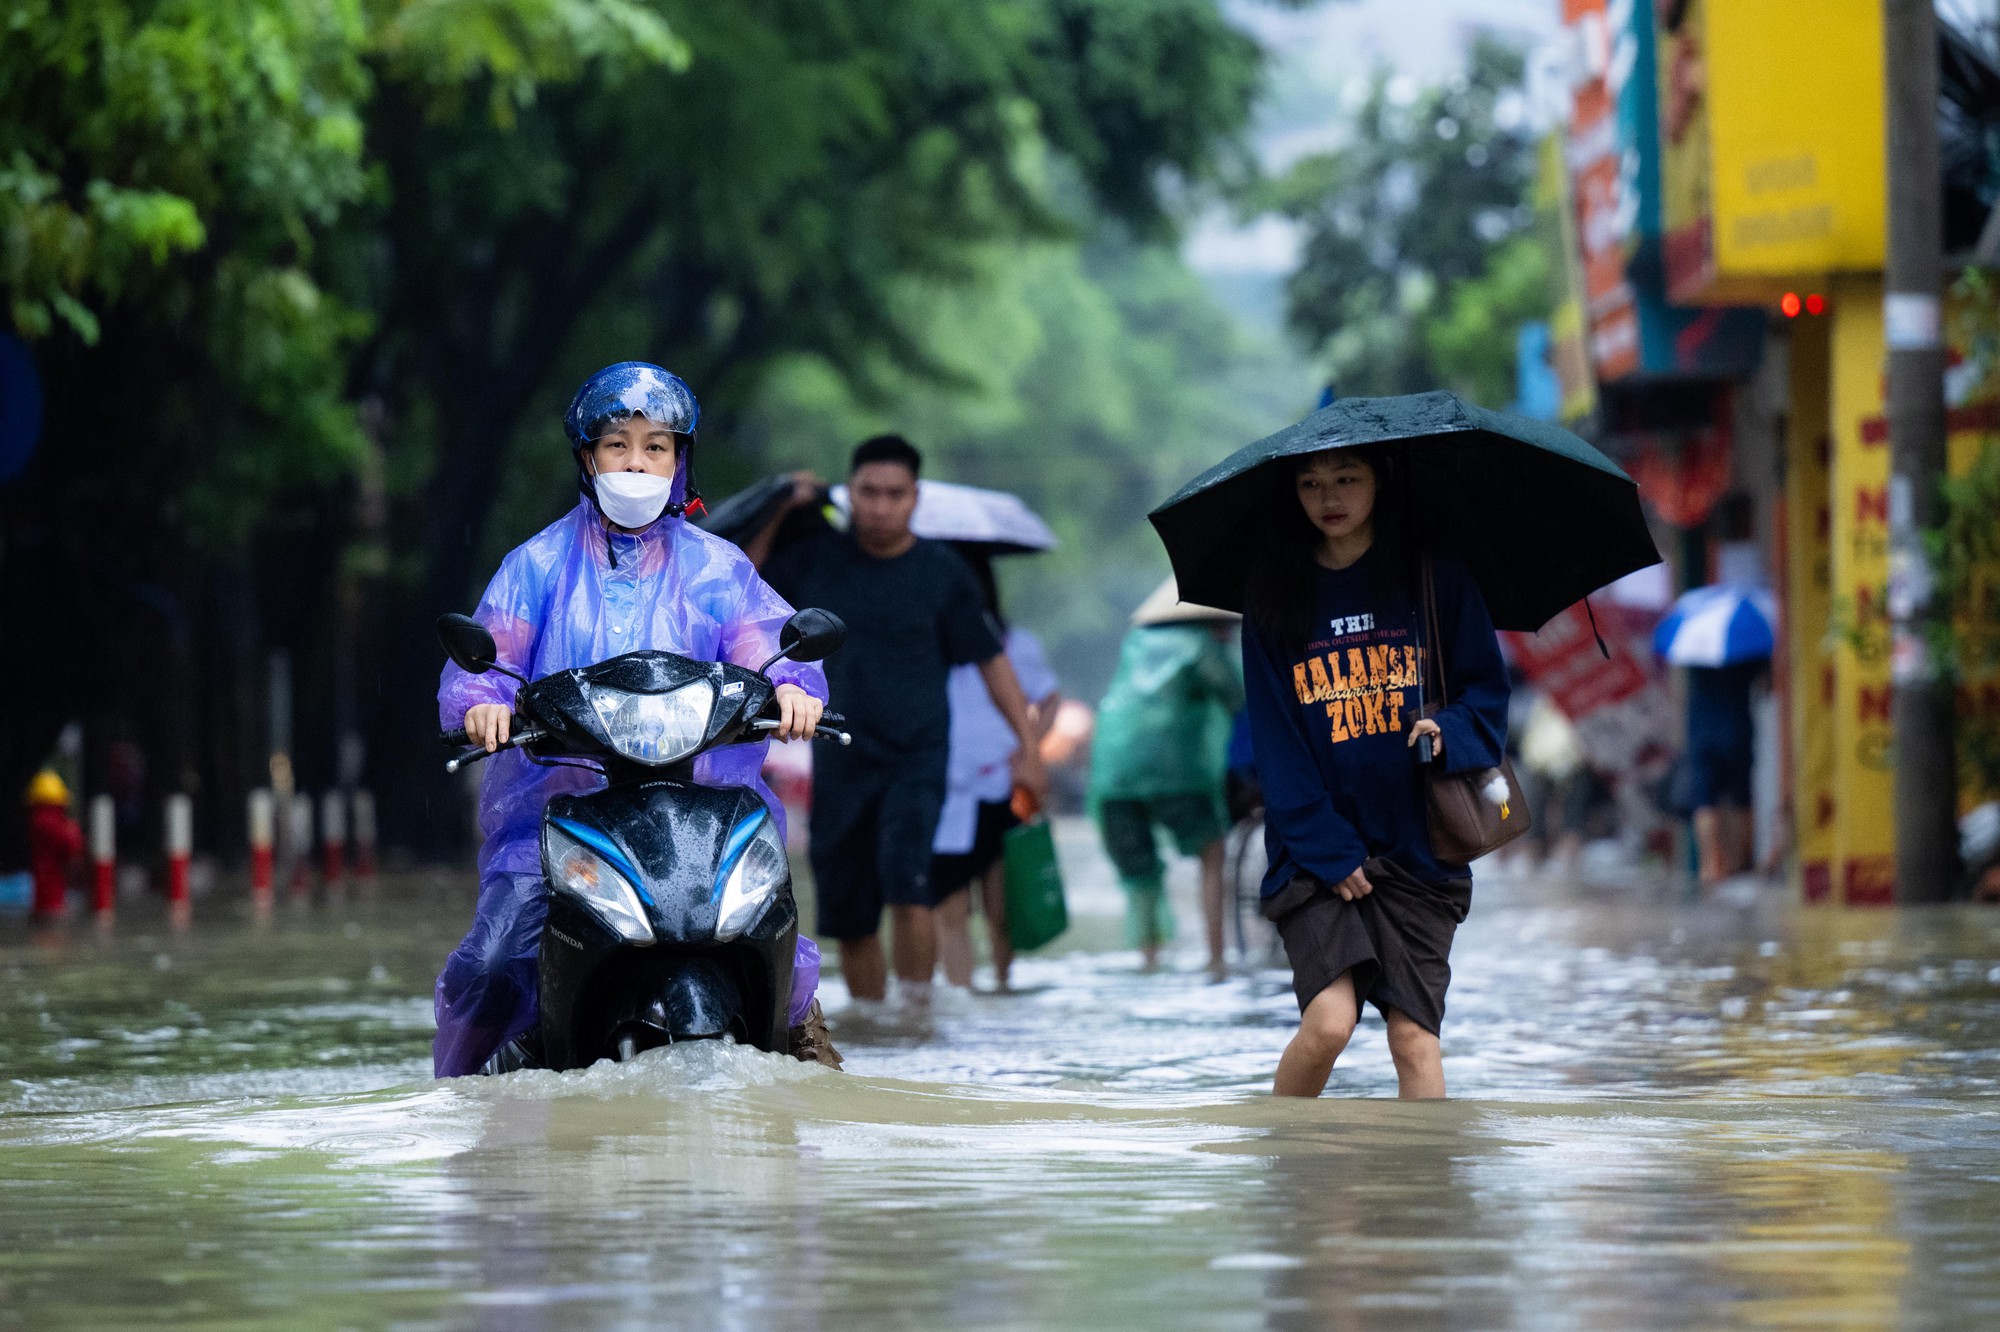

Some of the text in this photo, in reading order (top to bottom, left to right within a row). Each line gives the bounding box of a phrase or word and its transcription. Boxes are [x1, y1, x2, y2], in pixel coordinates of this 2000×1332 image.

[1330, 613, 1375, 636] THE
[640, 780, 685, 789] HONDA
[550, 925, 584, 951] HONDA
